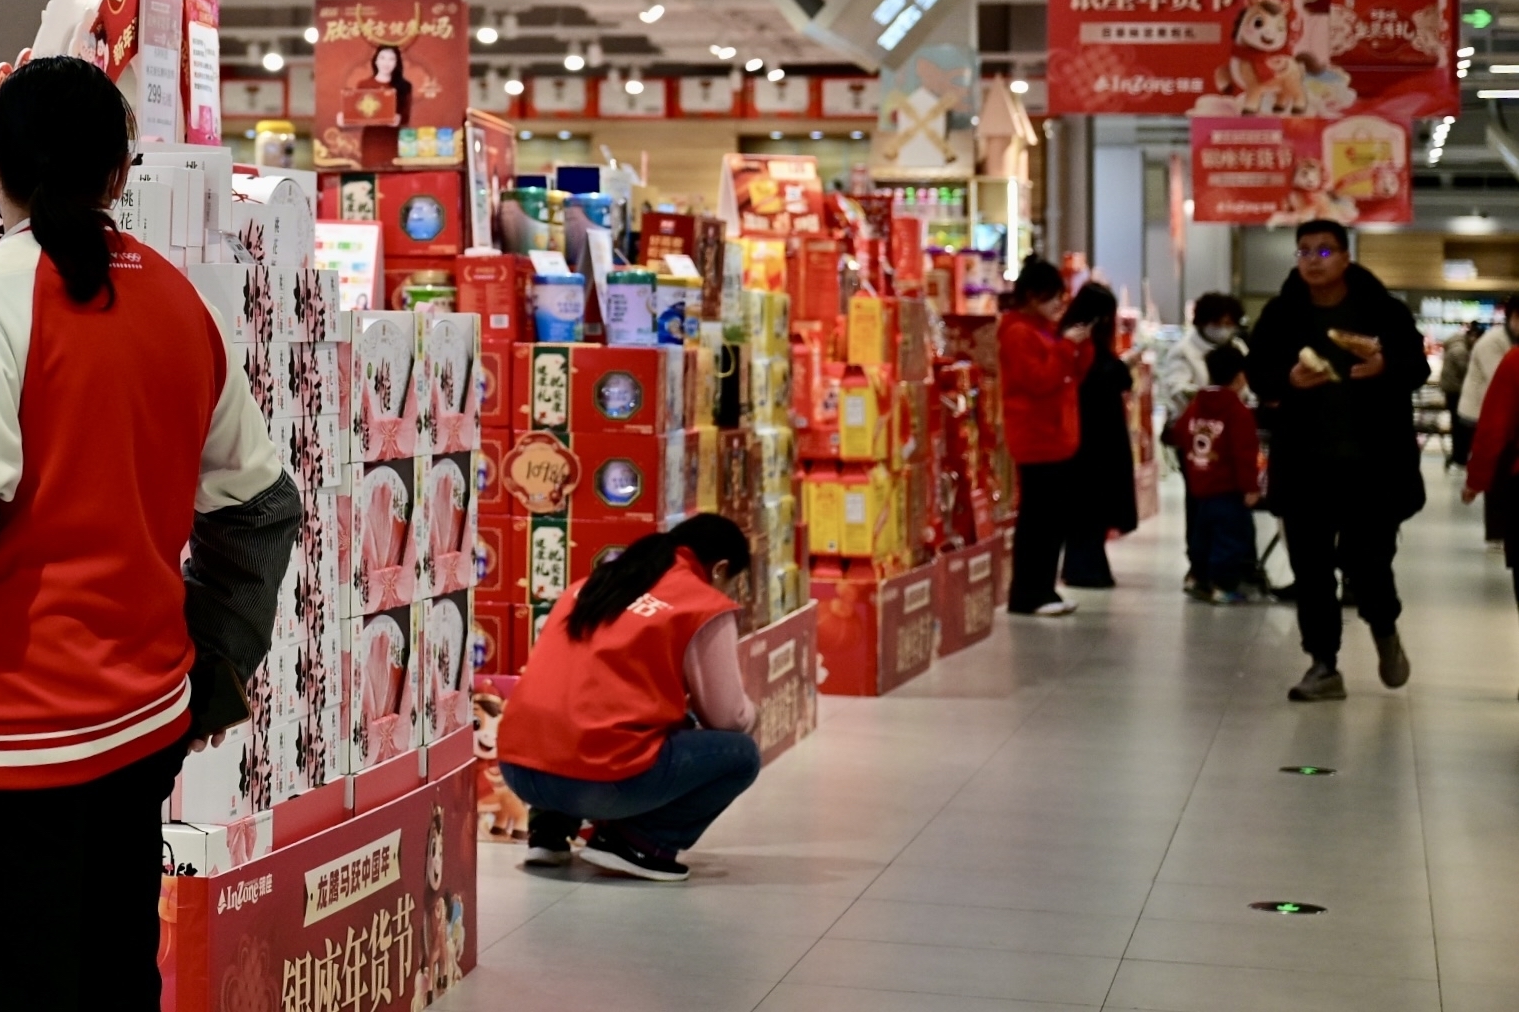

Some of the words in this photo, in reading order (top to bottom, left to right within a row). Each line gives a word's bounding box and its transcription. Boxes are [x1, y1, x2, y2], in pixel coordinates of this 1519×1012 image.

[227, 881, 259, 912] InZone
[259, 873, 273, 897] 银座
[316, 845, 391, 910] 龙腾马跃中国年
[282, 893, 416, 1012] 银座年货节
